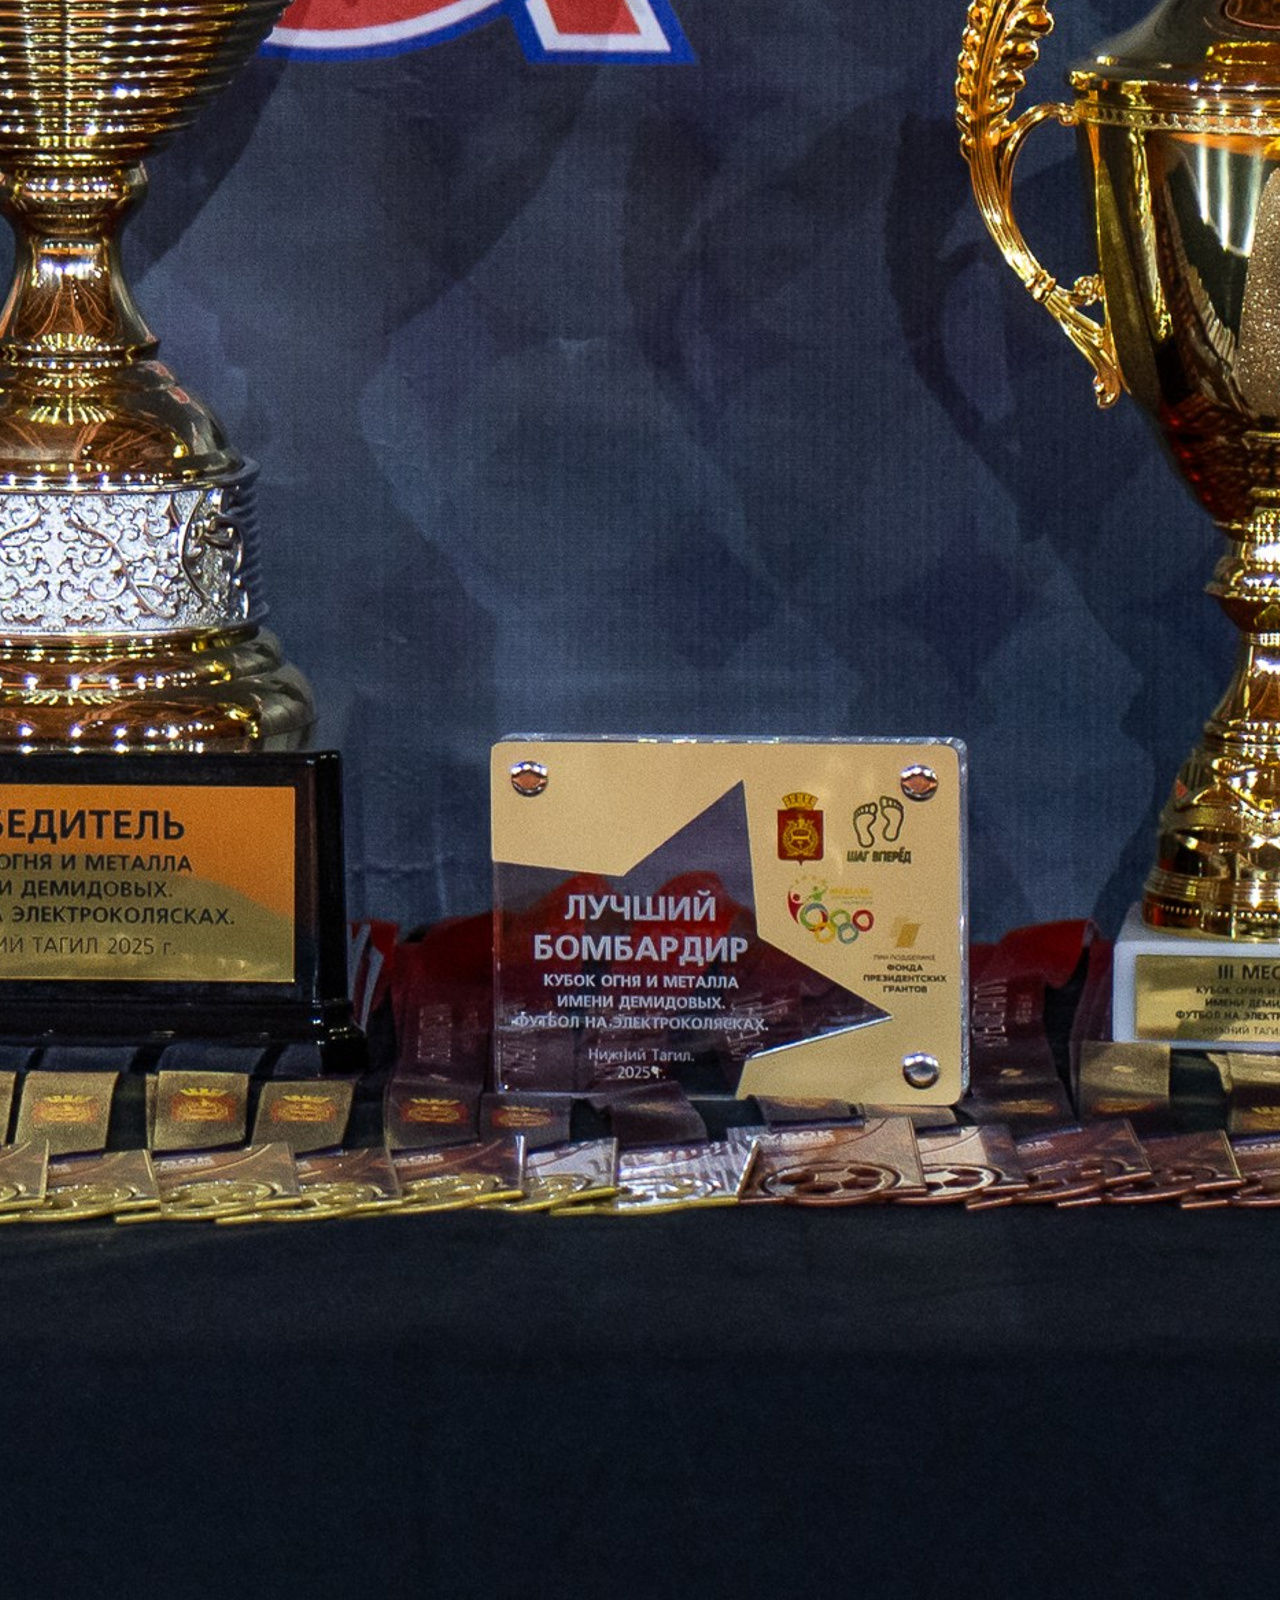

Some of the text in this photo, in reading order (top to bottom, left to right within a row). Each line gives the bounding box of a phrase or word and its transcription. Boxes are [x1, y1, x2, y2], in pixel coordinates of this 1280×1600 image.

[61, 854, 76, 871] И
[84, 854, 193, 872] МЕТАЛЛА
[20, 879, 173, 900] ДЕМИДОВЫХ.
[564, 890, 716, 922] ЛУЧШИЙ
[11, 905, 236, 926] ЭЛЕКТРОКОЛЯСКАХ.
[32, 936, 99, 955] ТАГИЛ
[107, 937, 155, 956] 2025
[533, 934, 749, 967] БОМБАРДИР
[886, 964, 924, 973] ФОНДА
[1218, 965, 1234, 980] III
[543, 974, 739, 989] КУБОК ОГНЯ И МЕТАЛЛА
[863, 974, 948, 984] ПРЕЗИДЕНТСКИХ
[882, 985, 928, 994] ГРАНТОВ
[557, 995, 726, 1011] ИМЕНИ ДЕМИДОВЫХ.
[513, 1013, 770, 1032] ФУТБОЛ НА ЭЛЕКТРОКОЛЯСКАХ.
[588, 1048, 695, 1063] Нижний Тагил.
[617, 1065, 651, 1079] 2025
